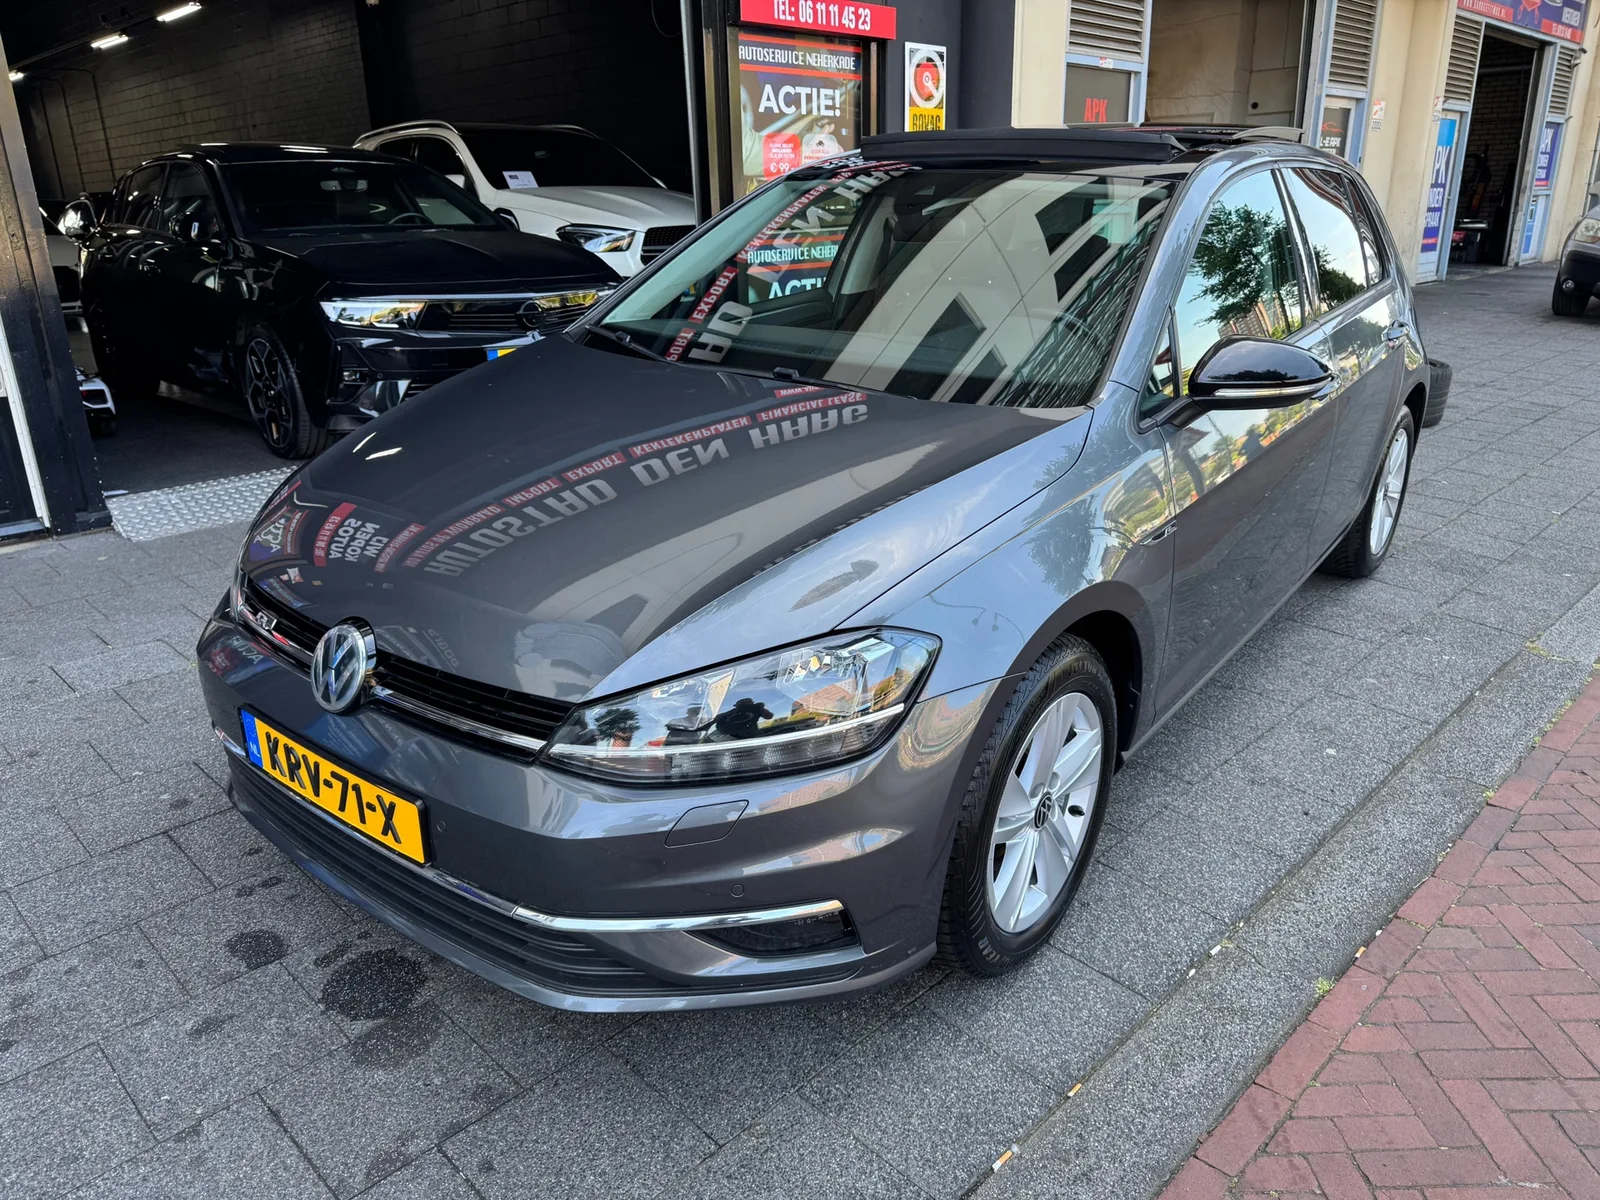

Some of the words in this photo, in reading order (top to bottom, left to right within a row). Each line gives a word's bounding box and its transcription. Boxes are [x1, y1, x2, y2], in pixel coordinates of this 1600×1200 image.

[773, 0, 795, 21] TEL:
[799, 0, 814, 24] 06
[816, 2, 826, 26] 11
[829, 4, 839, 27] 11
[842, 6, 856, 29] 45
[858, 8, 871, 31] 23
[738, 45, 804, 66] AUTOSERVICE
[805, 52, 856, 70] NEHERKADE
[758, 84, 841, 117] ACTIE!
[1084, 97, 1108, 123] APK
[1432, 145, 1450, 184] PK
[1428, 187, 1444, 208] NDER
[747, 246, 808, 264] AUTOSERVICE
[265, 731, 402, 844] KRV-71-X
